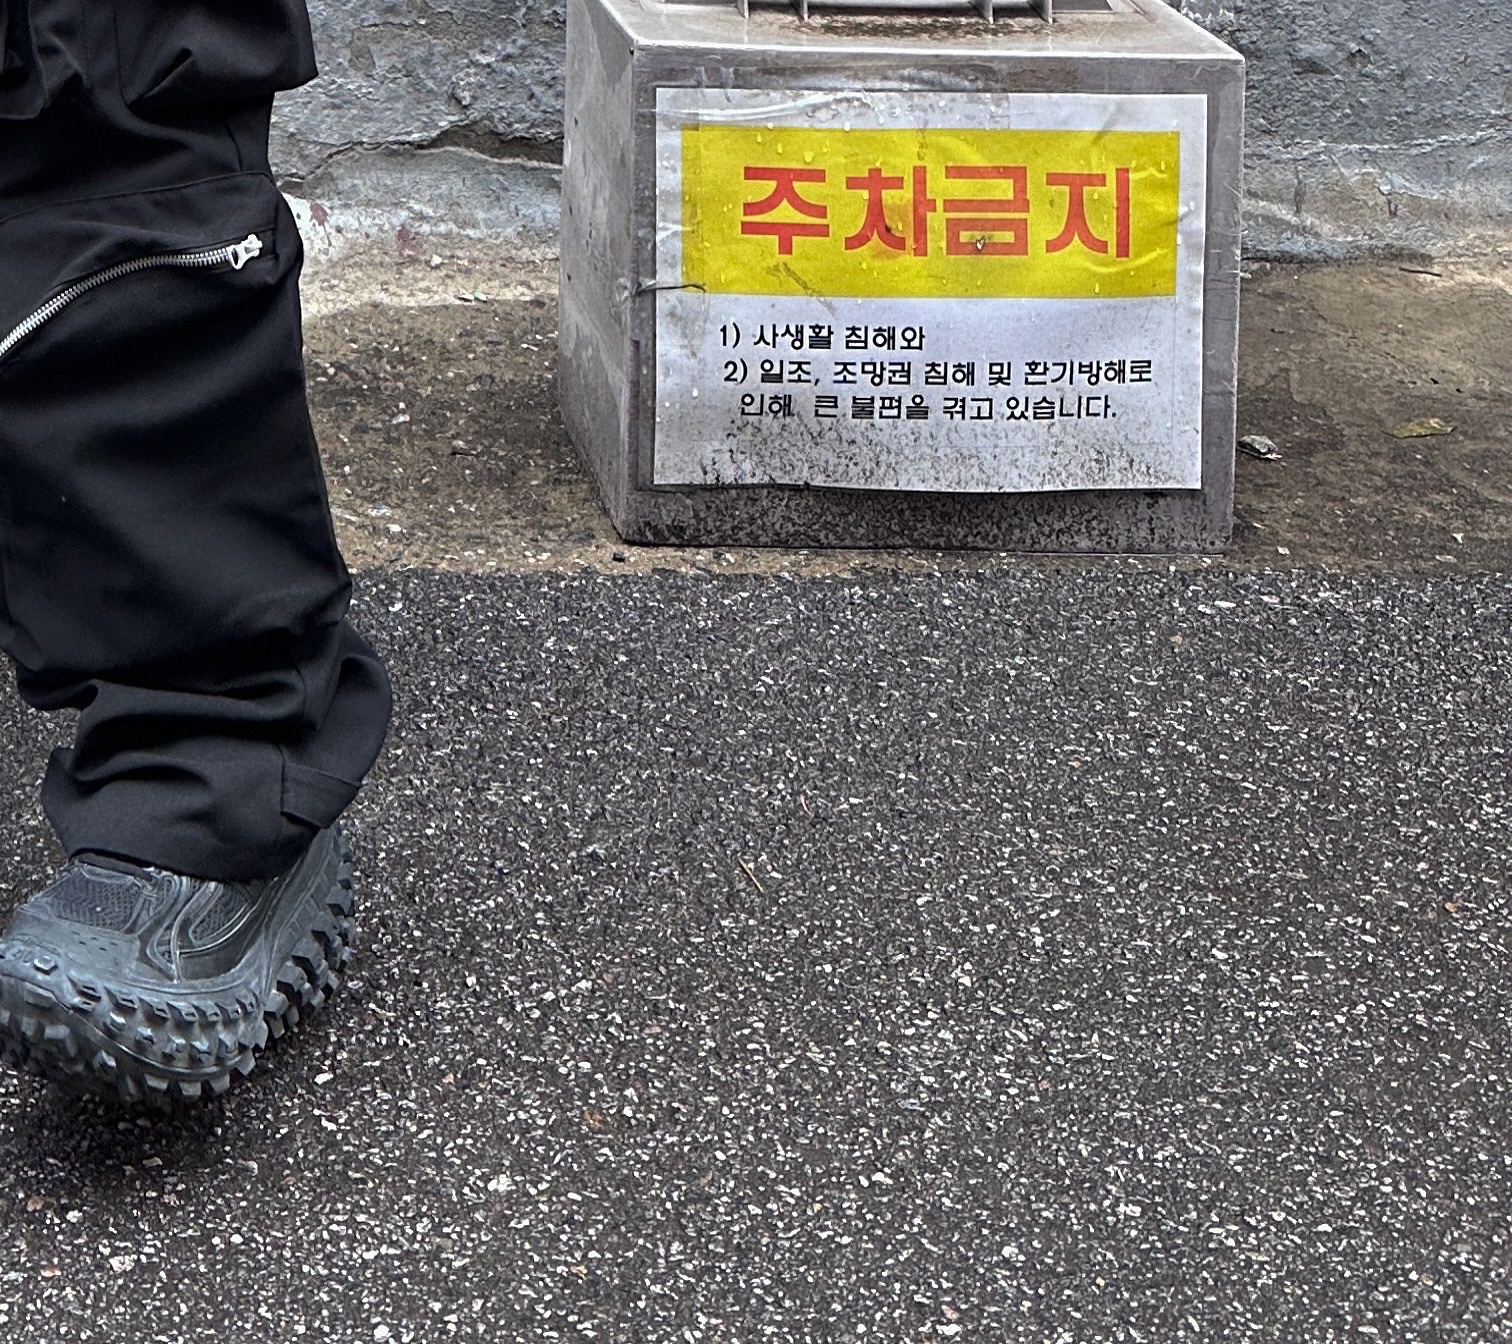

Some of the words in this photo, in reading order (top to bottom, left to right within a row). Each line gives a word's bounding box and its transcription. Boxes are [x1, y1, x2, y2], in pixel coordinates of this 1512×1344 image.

[740, 165, 1131, 259] 주차금지
[719, 322, 741, 349] 1)
[753, 323, 834, 350] 사생활
[844, 325, 926, 351] 침해와
[723, 358, 748, 385] 2)
[759, 359, 820, 387] 일조,
[832, 361, 912, 387] 조망권
[924, 360, 976, 387] 침해
[988, 361, 1012, 386] 및
[1024, 358, 1152, 386] 환기방해로
[740, 393, 793, 419] 인해
[814, 395, 839, 418] 큰
[851, 394, 930, 420] 불편을
[942, 395, 994, 421] 겪고
[1006, 394, 1117, 421] 있습니다.
